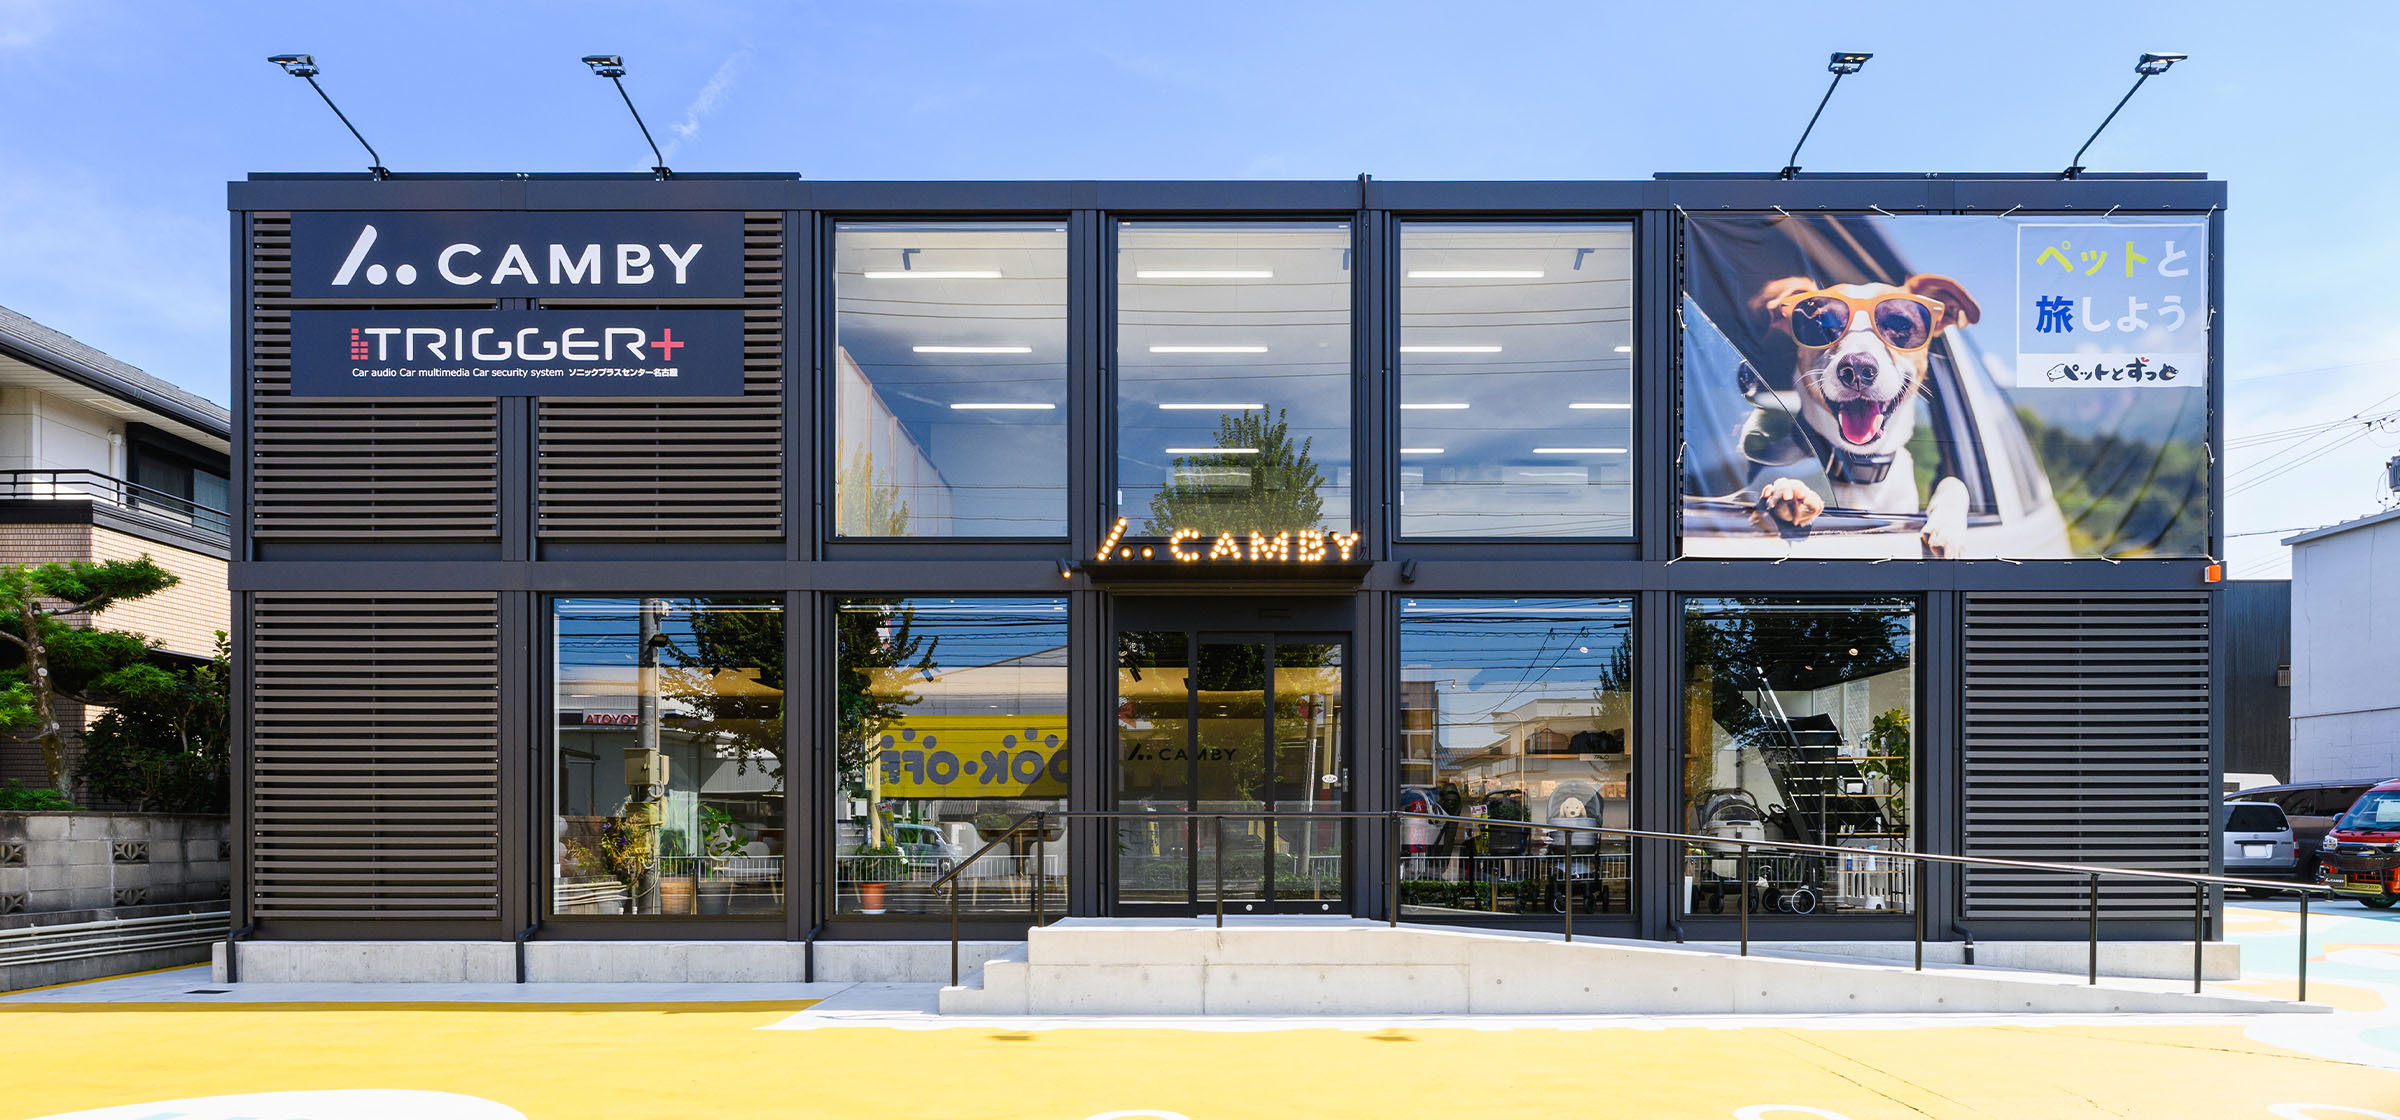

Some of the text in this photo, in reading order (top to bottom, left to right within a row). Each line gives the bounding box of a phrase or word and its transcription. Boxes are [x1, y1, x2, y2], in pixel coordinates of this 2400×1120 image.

[437, 243, 703, 285] CAMBY
[2036, 240, 2189, 277] ペットと
[2035, 295, 2186, 334] 旅しよう
[352, 367, 369, 377] Car
[371, 367, 397, 377] audio
[399, 367, 416, 377] Car
[418, 367, 470, 377] multimedia
[472, 367, 490, 377] Car
[491, 367, 528, 379] security
[530, 368, 564, 379] system
[1170, 528, 1361, 562] CAMBY
[1158, 748, 1237, 761] CAMBY
